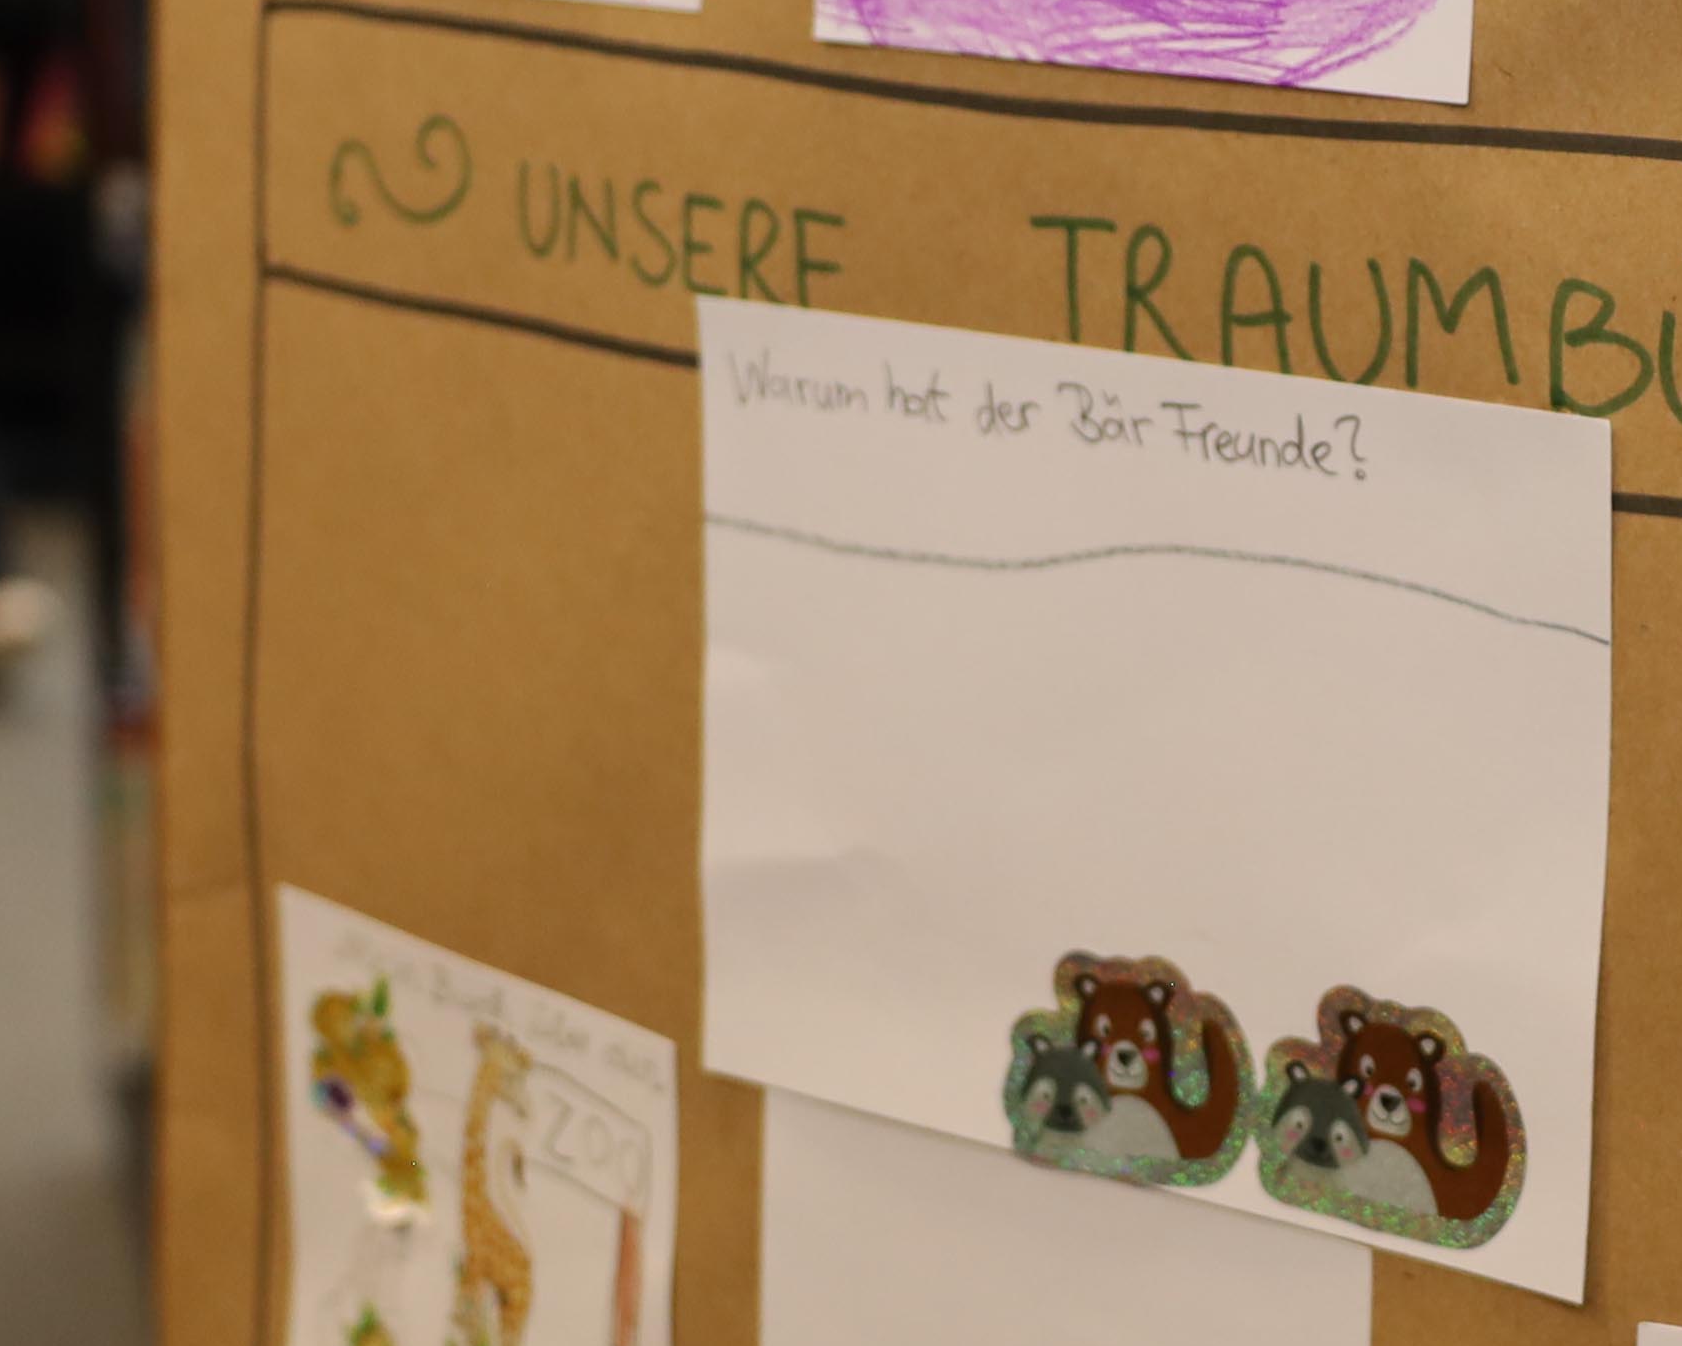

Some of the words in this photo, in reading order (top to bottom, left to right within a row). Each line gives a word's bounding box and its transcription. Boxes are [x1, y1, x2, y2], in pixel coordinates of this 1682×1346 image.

[728, 350, 869, 414] Warum
[977, 383, 1041, 435] der
[1056, 381, 1154, 448] Bär
[1161, 401, 1370, 482] Freunde?
